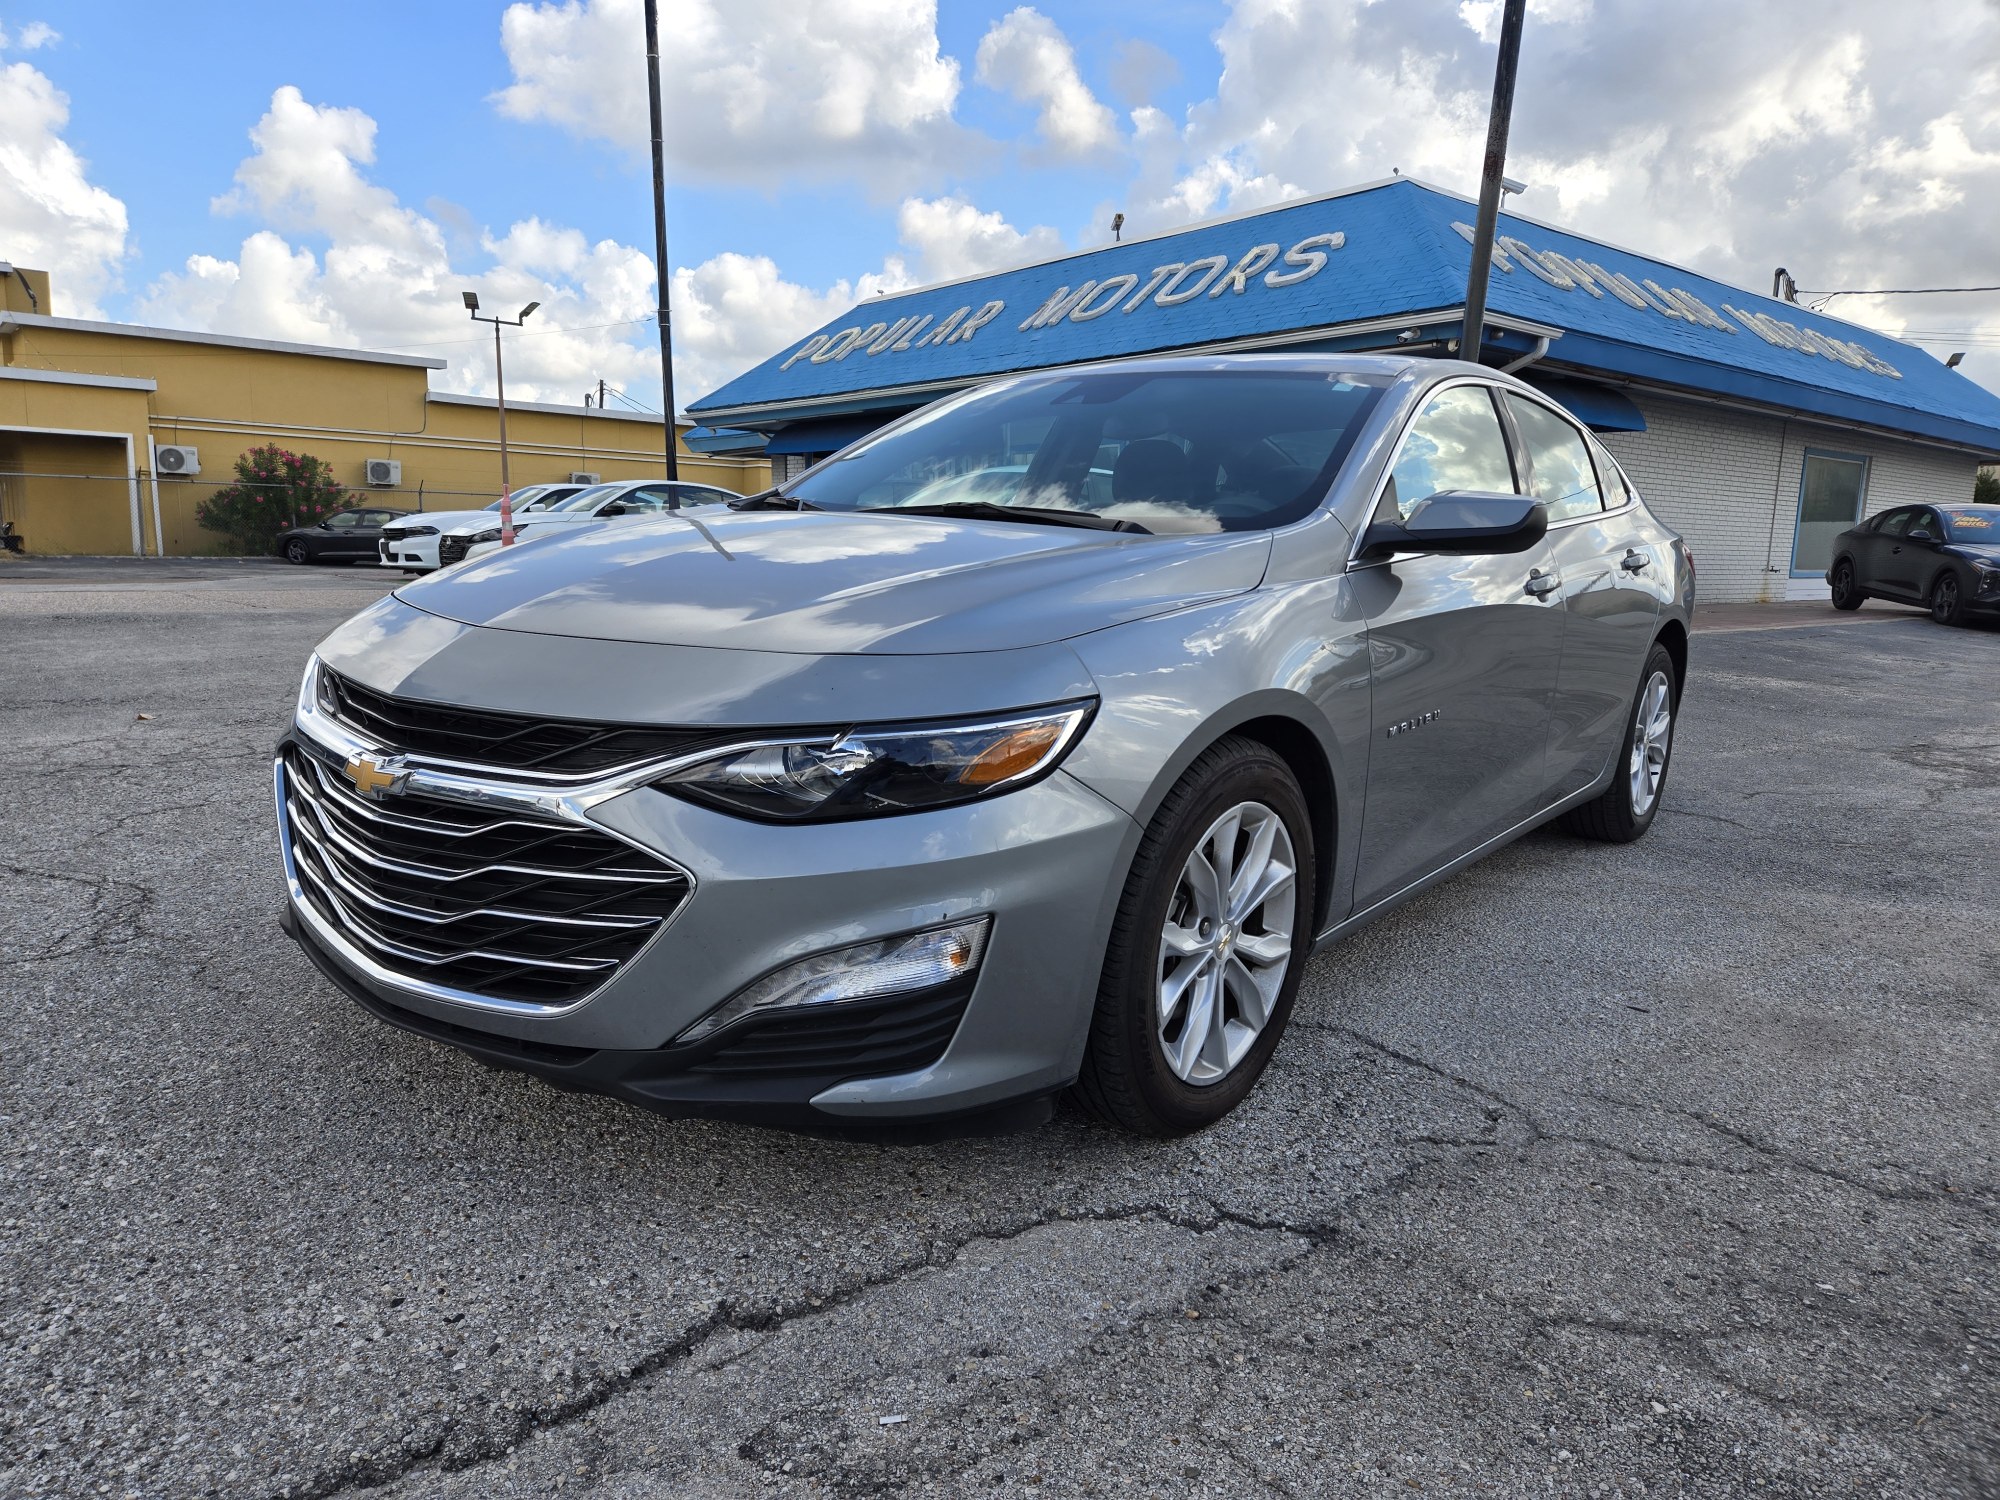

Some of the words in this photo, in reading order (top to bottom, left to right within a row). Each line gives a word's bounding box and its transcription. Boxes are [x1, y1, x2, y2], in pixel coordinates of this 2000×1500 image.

[779, 300, 1005, 372] POPULAR
[1018, 231, 1345, 332] MOTORS
[1387, 709, 1440, 739] MALIBU
